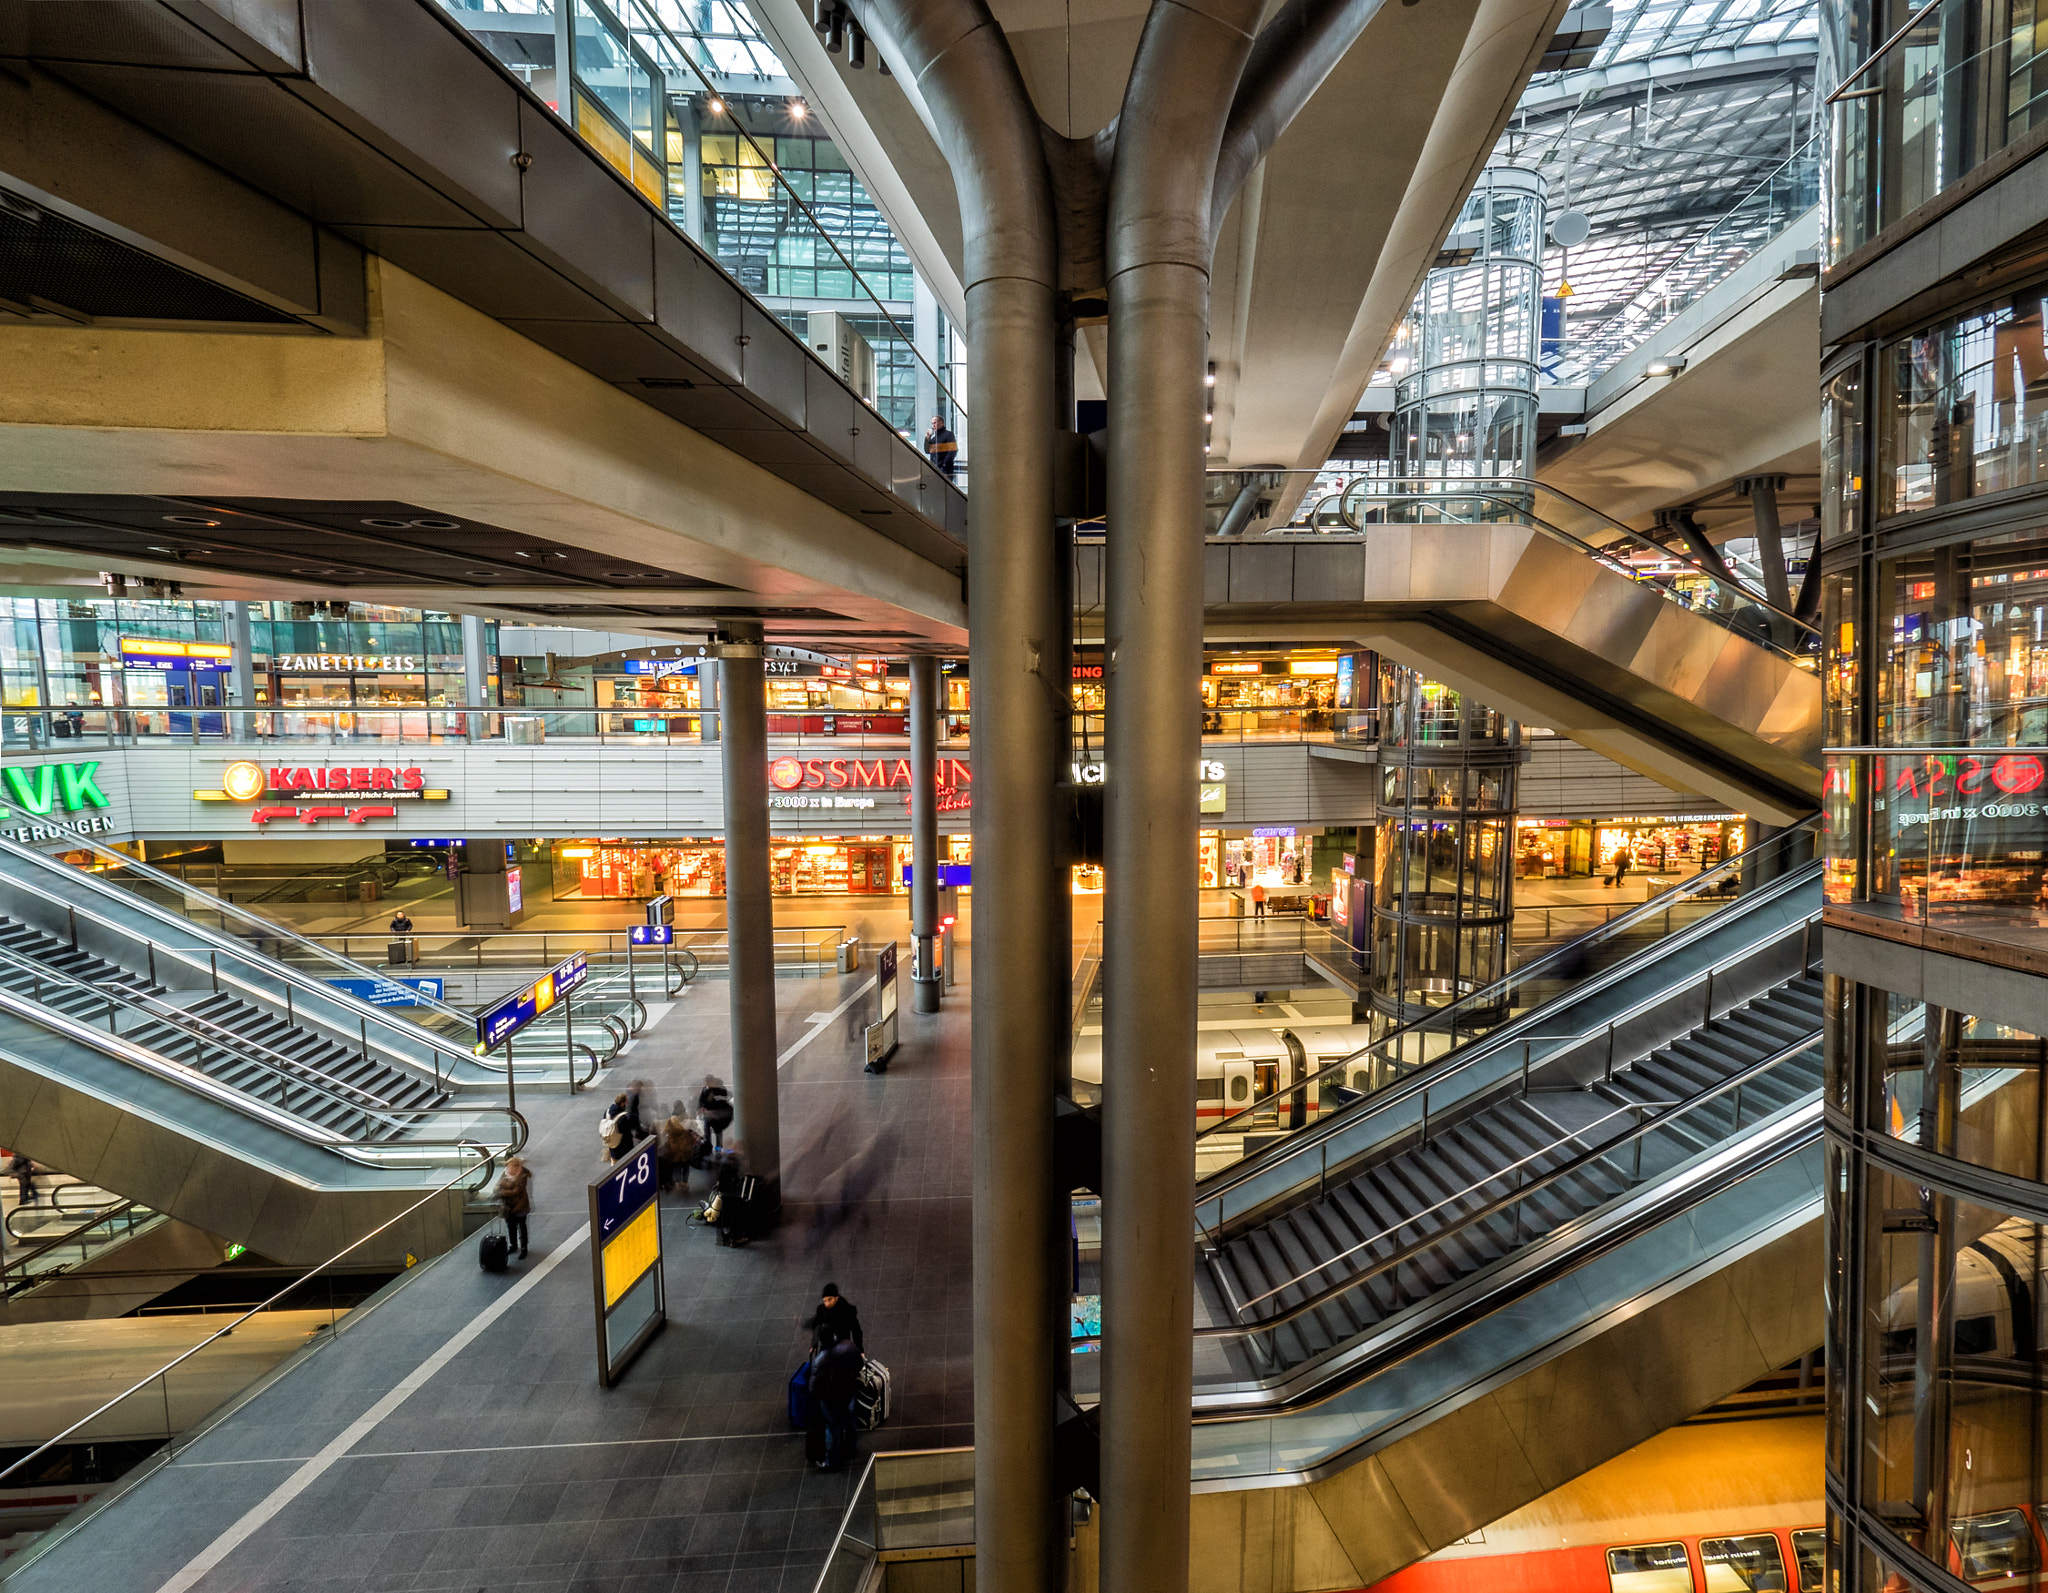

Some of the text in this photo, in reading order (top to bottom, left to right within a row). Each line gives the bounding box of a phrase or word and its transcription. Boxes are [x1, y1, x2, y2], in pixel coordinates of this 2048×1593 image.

[281, 656, 414, 671] ZANETTI EIS
[269, 767, 424, 789] KAISER'S
[0, 761, 110, 819] VK
[775, 796, 808, 808] 3000
[822, 796, 832, 808] in
[835, 796, 875, 809] Europa
[633, 926, 645, 942] 4
[654, 926, 665, 941] 3
[615, 1152, 650, 1204] 7-8
[87, 1446, 94, 1461] 1
